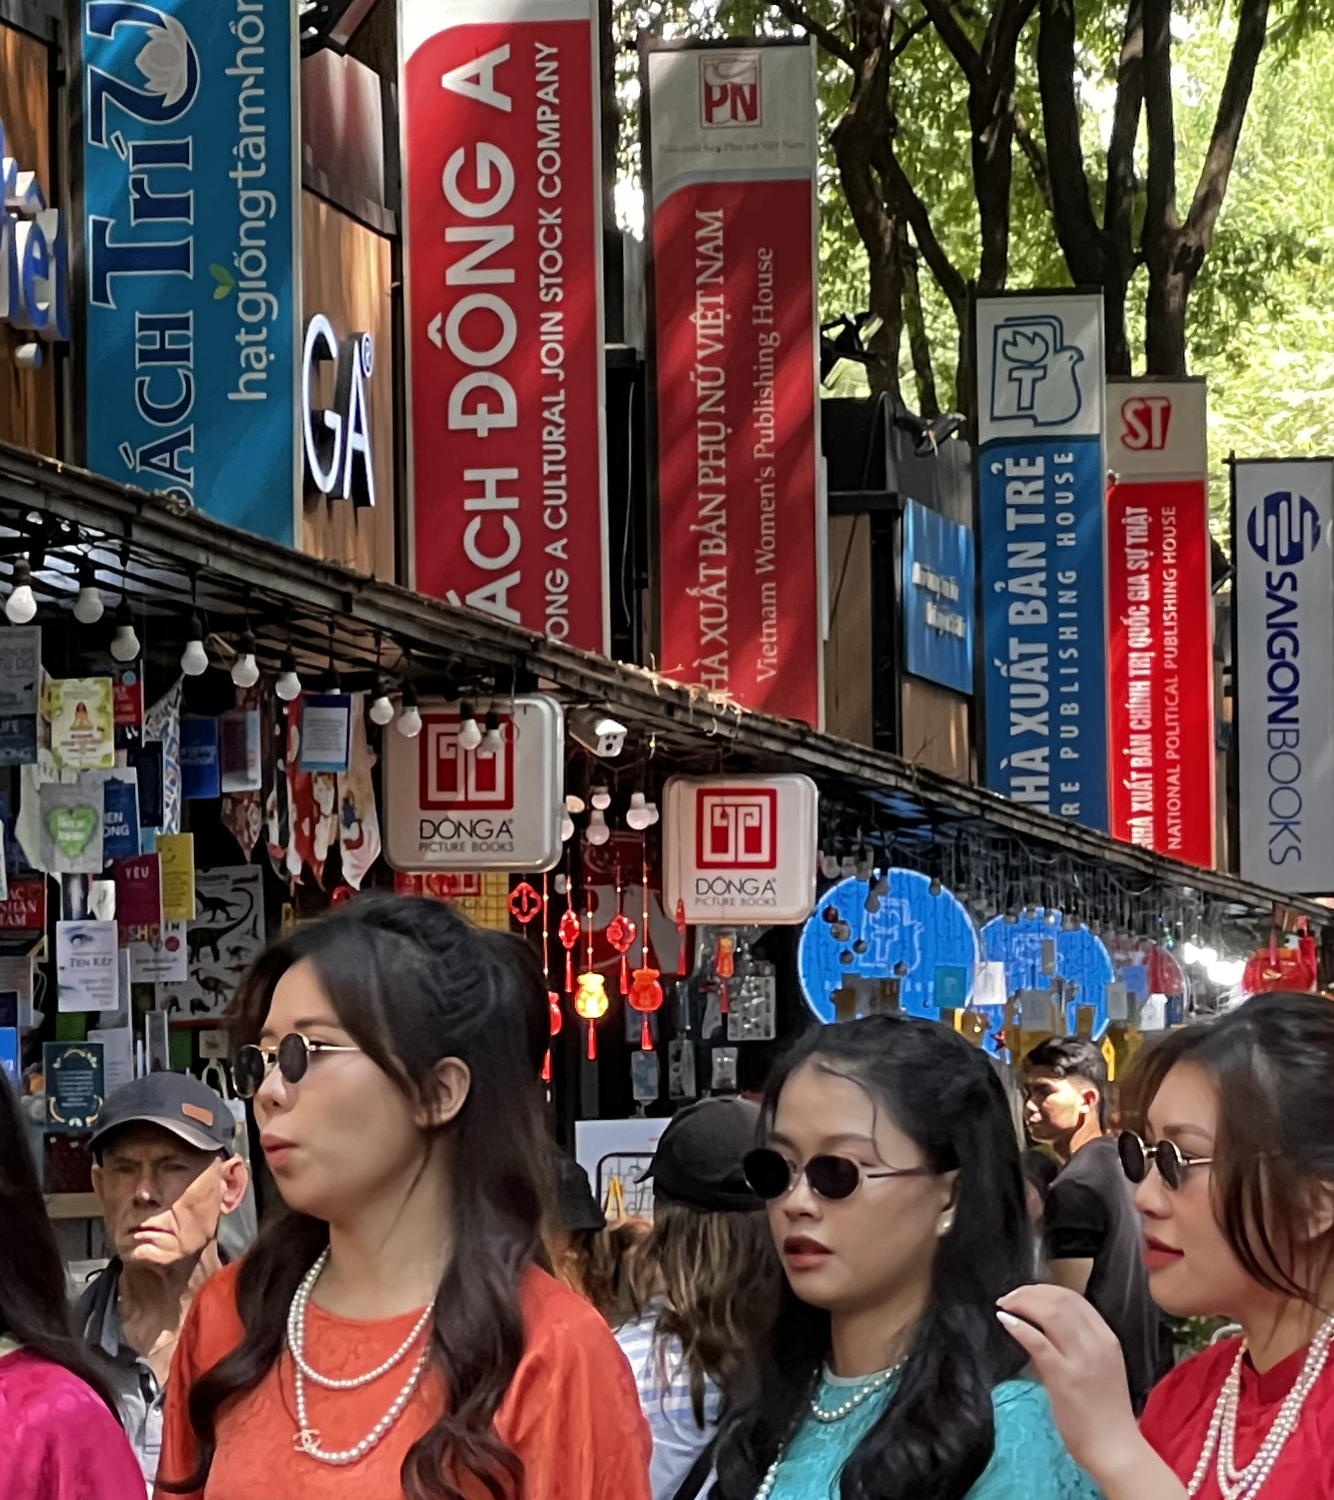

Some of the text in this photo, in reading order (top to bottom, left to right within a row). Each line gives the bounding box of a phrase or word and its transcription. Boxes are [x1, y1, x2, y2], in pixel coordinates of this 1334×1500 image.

[442, 43, 513, 113] A
[534, 42, 562, 198] COMPANY
[538, 207, 564, 302] STOCK
[695, 209, 724, 285] NAM
[428, 142, 518, 437] ĐÔNG
[688, 291, 731, 359] VIỆT
[540, 312, 566, 381] JOIN
[689, 363, 726, 414] NỮ
[1121, 397, 1171, 450] ST
[542, 389, 569, 530] CULTURAL
[698, 421, 732, 485] PHỤ
[752, 247, 780, 682] Vietnam Women's Publishing House
[690, 493, 727, 556] BẢN
[991, 456, 1046, 531] TRẺ
[1054, 452, 1077, 546] HOUSE
[544, 538, 569, 559] A
[994, 542, 1048, 625] BẢN
[685, 562, 729, 645] XUẤT
[1127, 574, 1151, 601] GIA
[993, 637, 1050, 736] XUẤT
[1057, 571, 1080, 759] PUBLISHING
[1161, 506, 1182, 850] NATIONAL POLITICAL PUBLISHING HOUSE
[1265, 570, 1303, 866] SAIGONBOOKS
[419, 842, 515, 853] PICTURE BOOKS
[695, 897, 777, 907] PICTURE BOOKS
